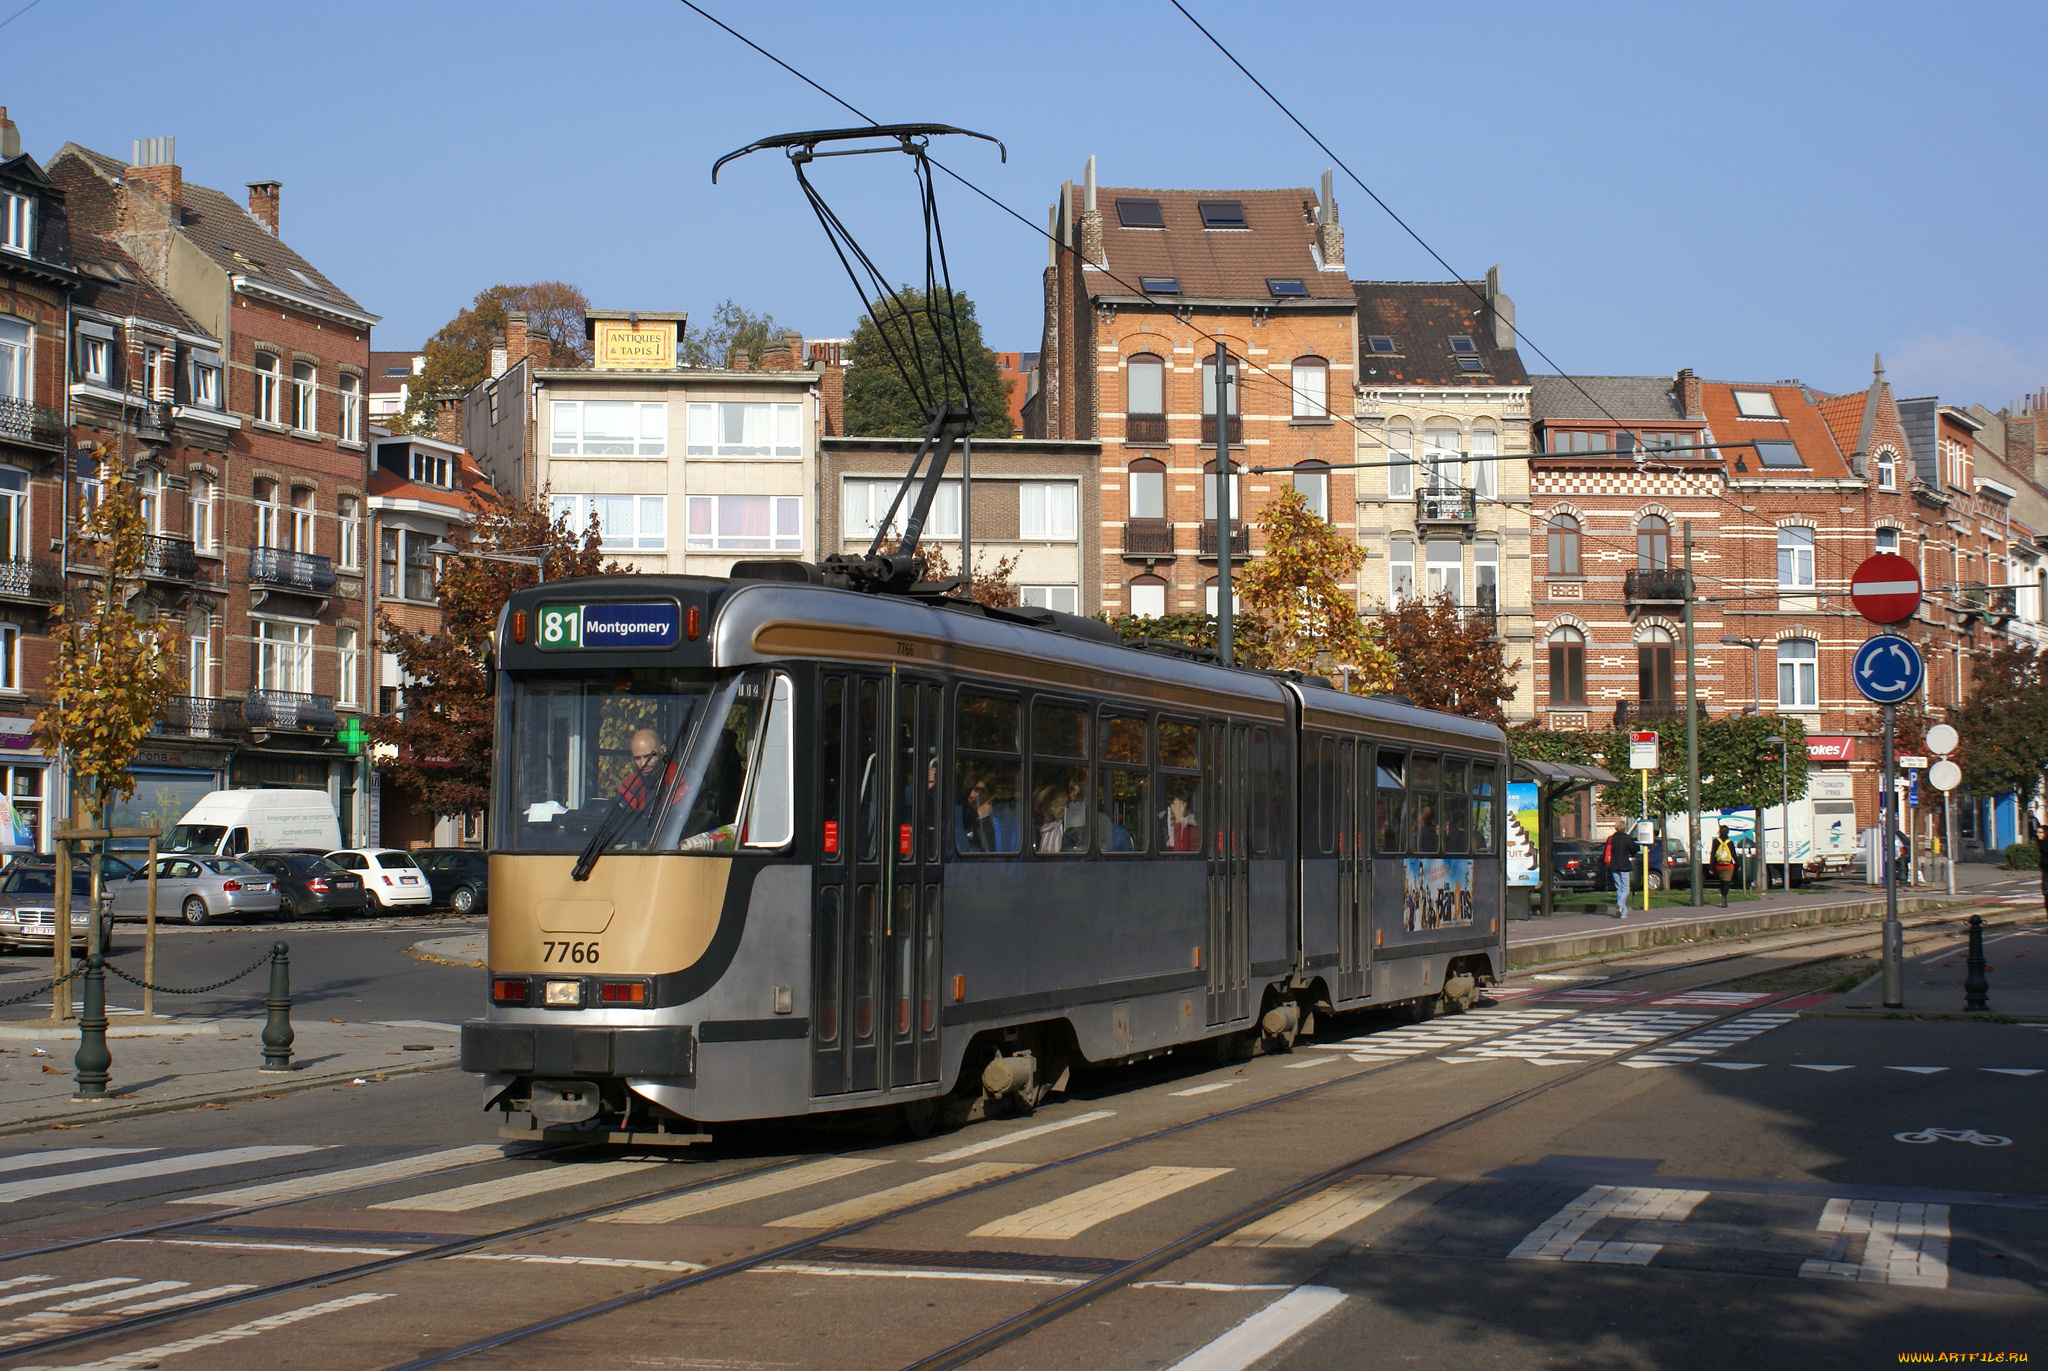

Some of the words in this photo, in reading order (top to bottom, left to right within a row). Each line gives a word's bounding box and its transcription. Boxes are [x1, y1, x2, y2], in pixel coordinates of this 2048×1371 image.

[610, 334, 661, 343] ANTIQUES
[620, 346, 652, 355] TAPIS
[544, 612, 578, 642] 81
[586, 621, 670, 636] Montgomery
[896, 641, 914, 657] 7766
[1910, 772, 1918, 788] P
[543, 941, 600, 964] 7766
